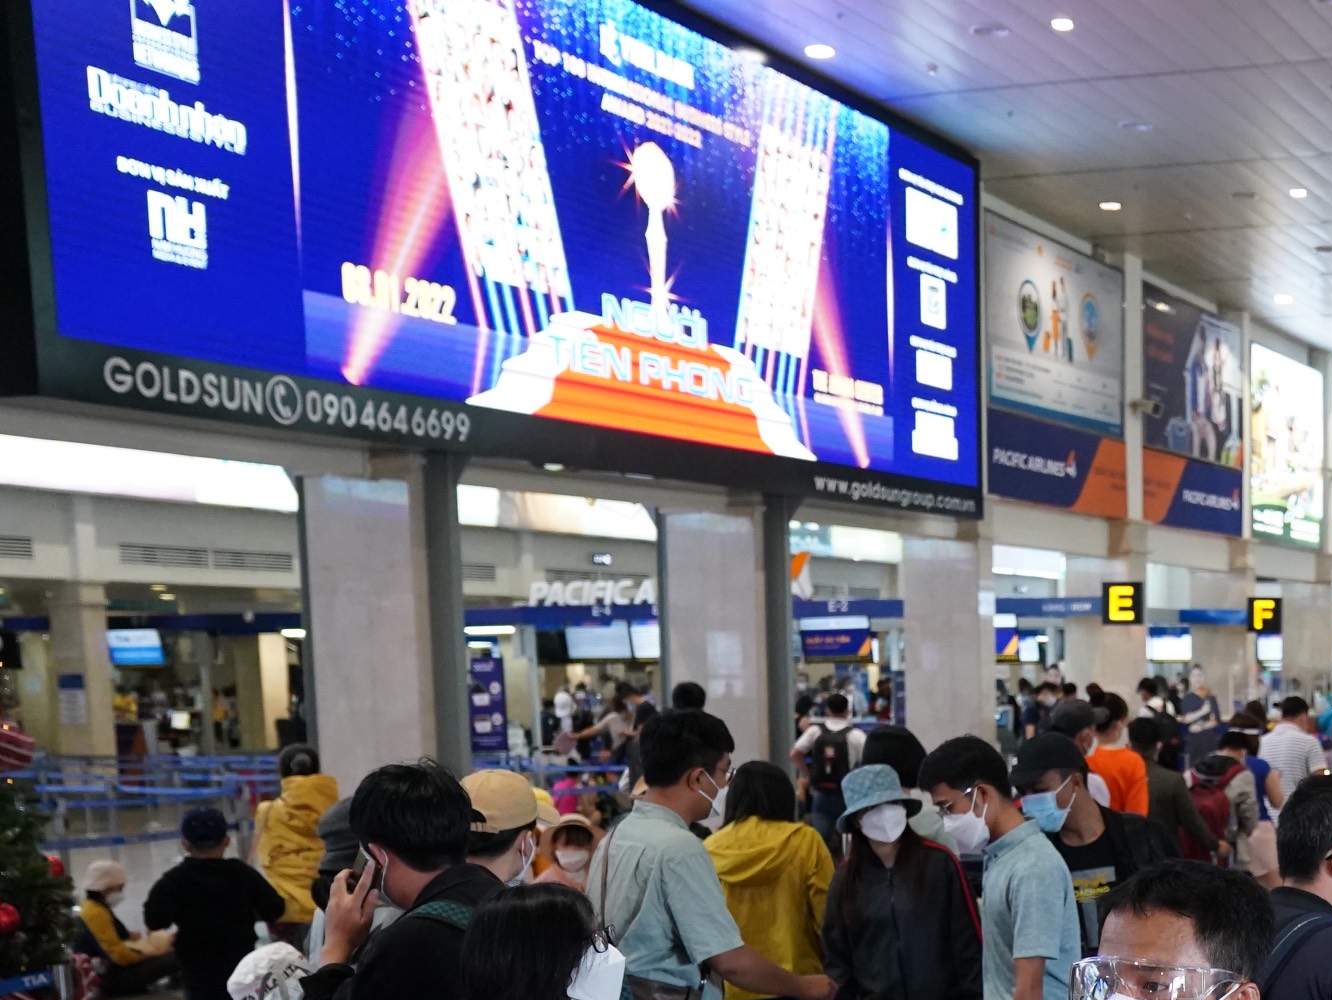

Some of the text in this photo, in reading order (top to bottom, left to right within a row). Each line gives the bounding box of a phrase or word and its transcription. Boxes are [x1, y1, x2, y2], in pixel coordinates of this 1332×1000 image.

[637, 350, 756, 406] PHONG
[103, 356, 471, 442] GOLDSUN 0904646699
[527, 578, 633, 607] PACIFIC
[1108, 585, 1135, 621] E
[1252, 598, 1276, 630] F
